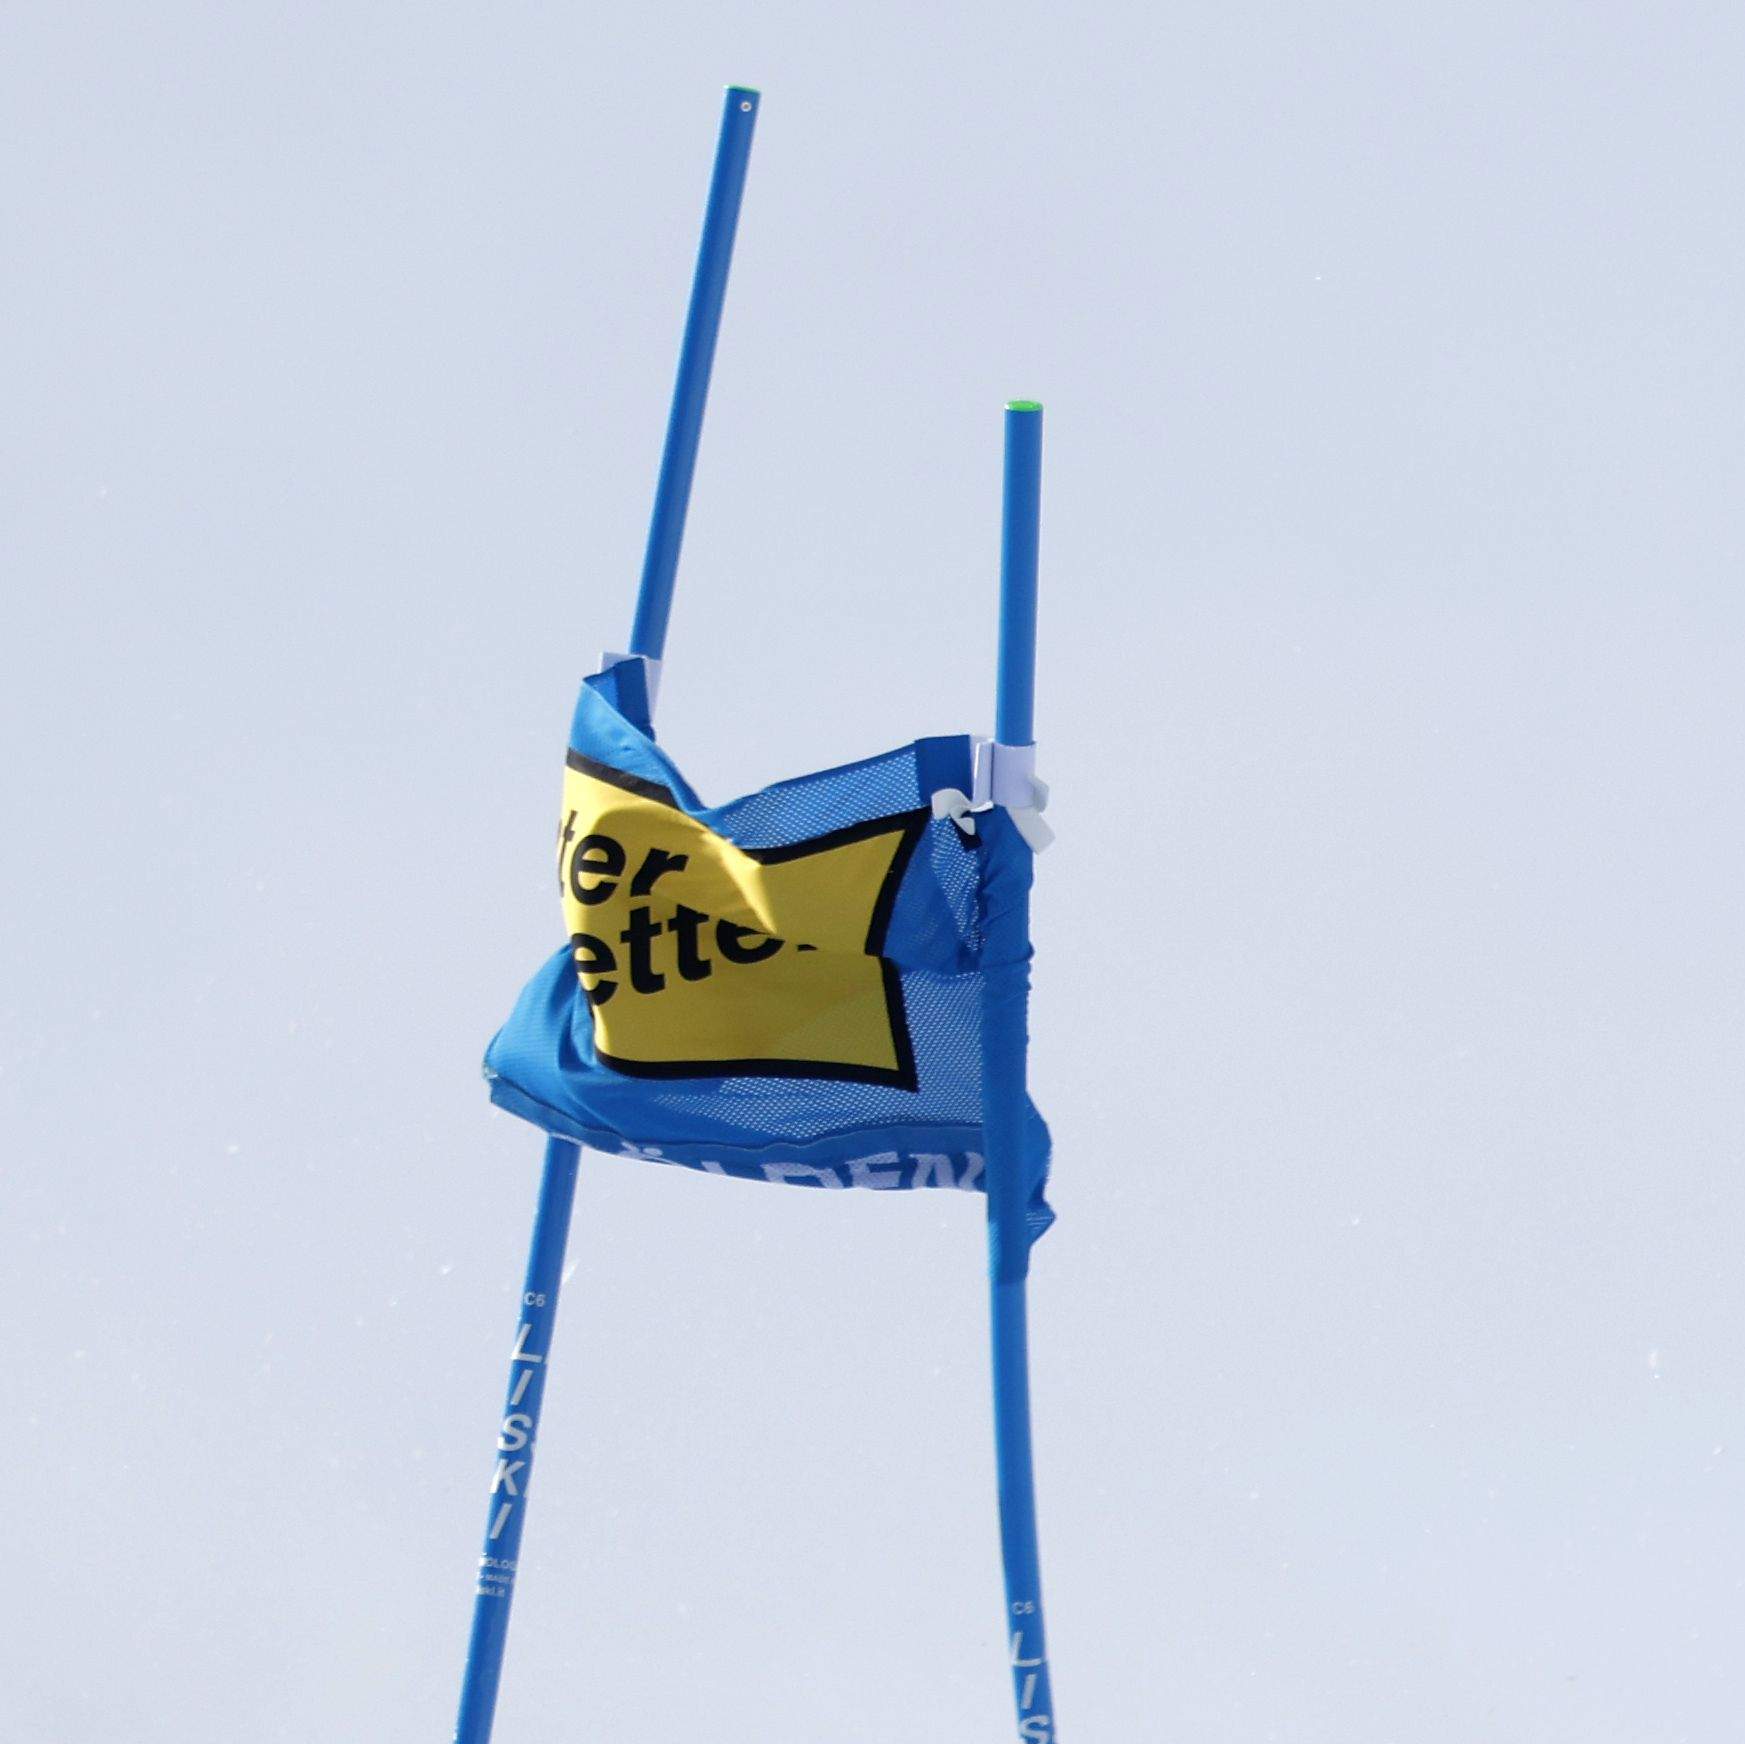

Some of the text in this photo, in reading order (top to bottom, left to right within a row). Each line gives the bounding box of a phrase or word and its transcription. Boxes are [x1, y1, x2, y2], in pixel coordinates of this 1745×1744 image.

[560, 810, 690, 906] ter
[571, 904, 818, 1006] ette
[488, 1323, 543, 1540] LISKI
